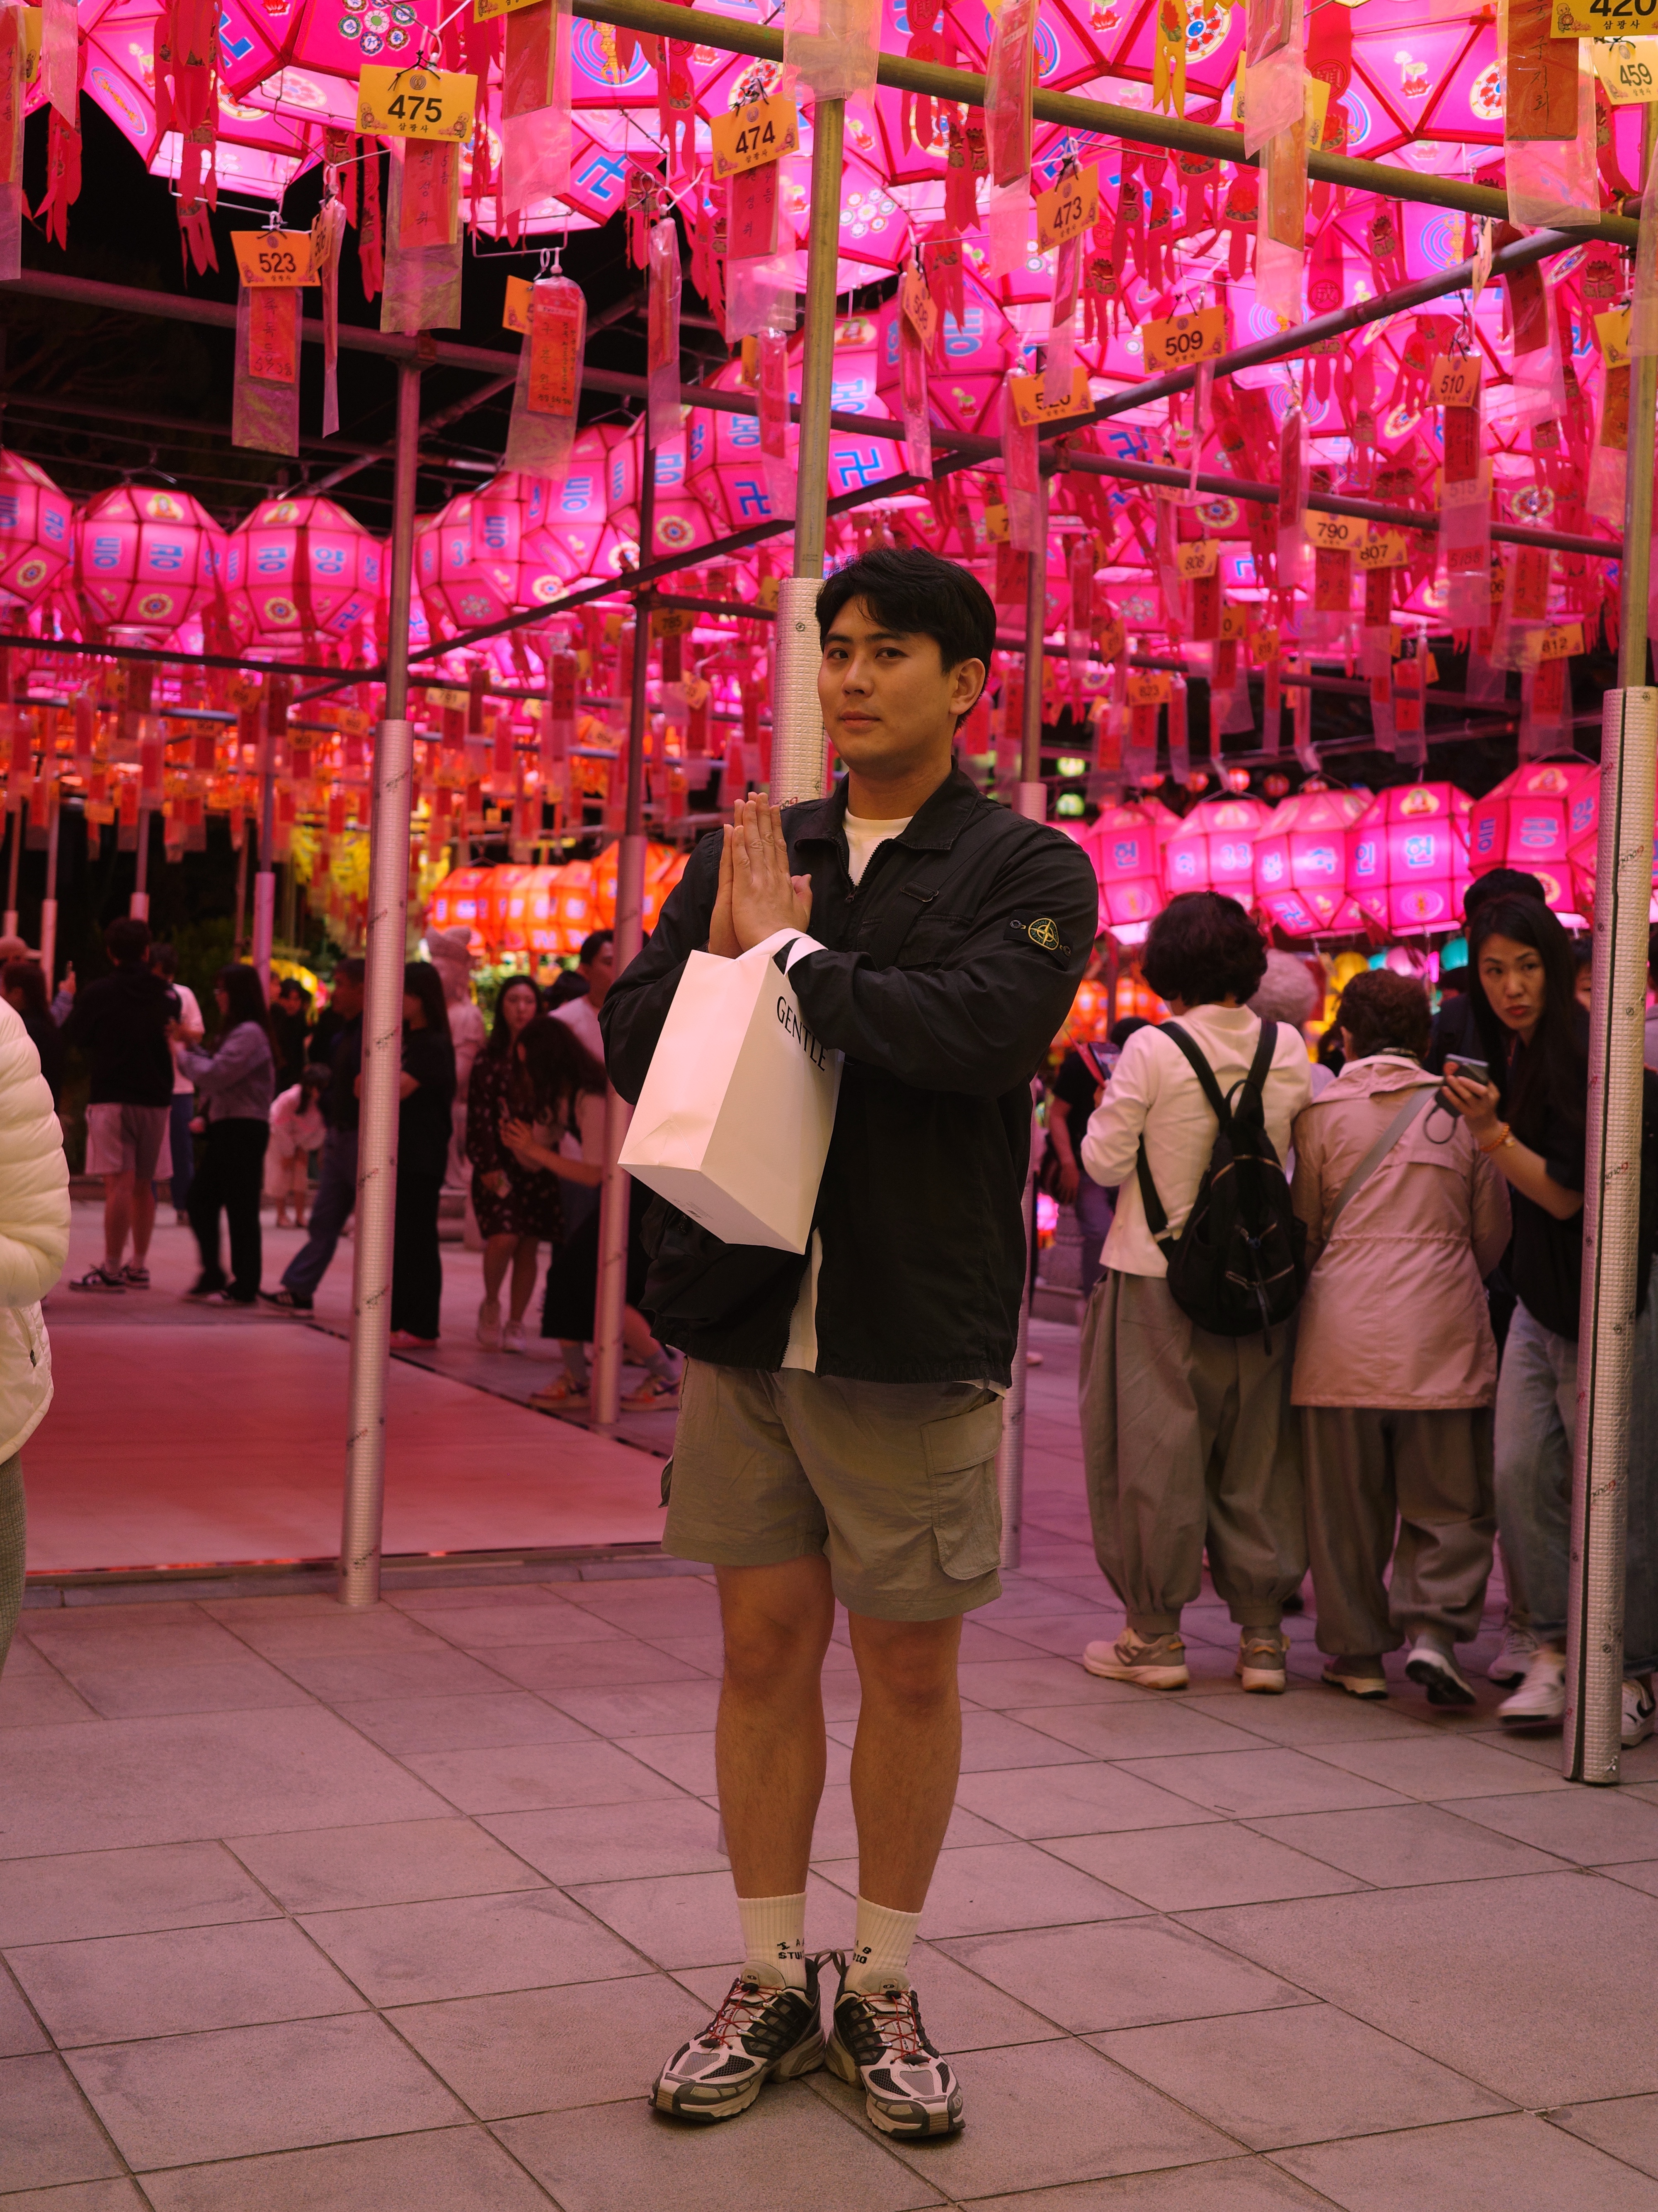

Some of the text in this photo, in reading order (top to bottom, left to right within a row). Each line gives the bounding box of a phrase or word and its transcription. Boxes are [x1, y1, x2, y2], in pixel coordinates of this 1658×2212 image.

[1603, 19, 1640, 30] 삼광사
[1620, 63, 1652, 87] 459
[388, 94, 442, 122] 475
[398, 123, 429, 133] 삼광사
[736, 120, 776, 154] 474
[1053, 196, 1083, 229] 473
[259, 252, 297, 273] 523
[1166, 330, 1203, 357] 509
[1440, 375, 1465, 394] 510
[1317, 522, 1349, 539] 790
[94, 537, 120, 568] 등
[1355, 844, 1374, 873] 인
[1033, 920, 1048, 928] STONE
[1031, 930, 1043, 943] ISLAND
[776, 995, 827, 1072] GENTLE
